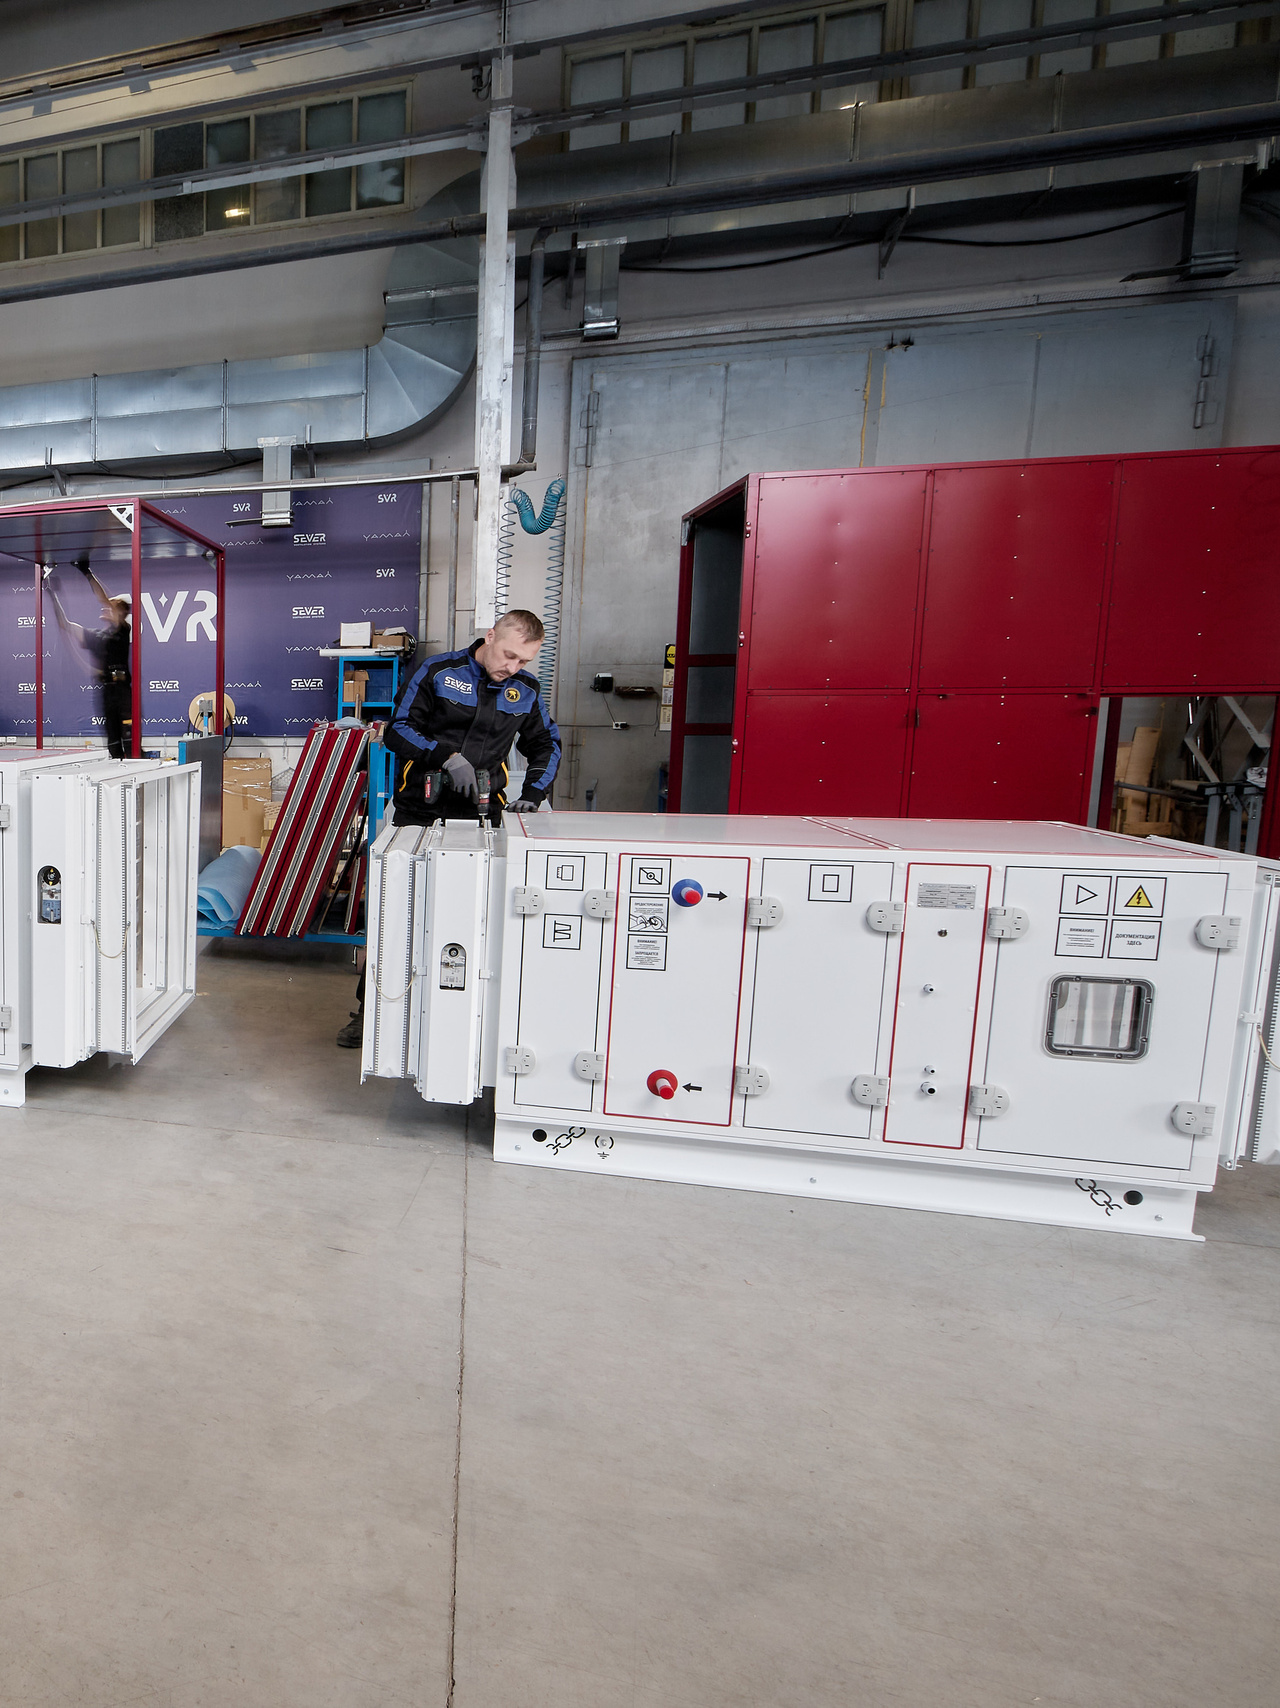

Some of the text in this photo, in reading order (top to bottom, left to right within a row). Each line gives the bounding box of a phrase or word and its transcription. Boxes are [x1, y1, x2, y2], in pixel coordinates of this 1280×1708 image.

[378, 493, 397, 503] SVR
[233, 503, 251, 512] SVR
[293, 533, 326, 543] SEVER
[376, 568, 395, 578] SVR
[292, 606, 325, 616] SEVER
[149, 680, 179, 690] SEVER
[291, 678, 323, 688] SEVER
[444, 676, 473, 692] SEVER
